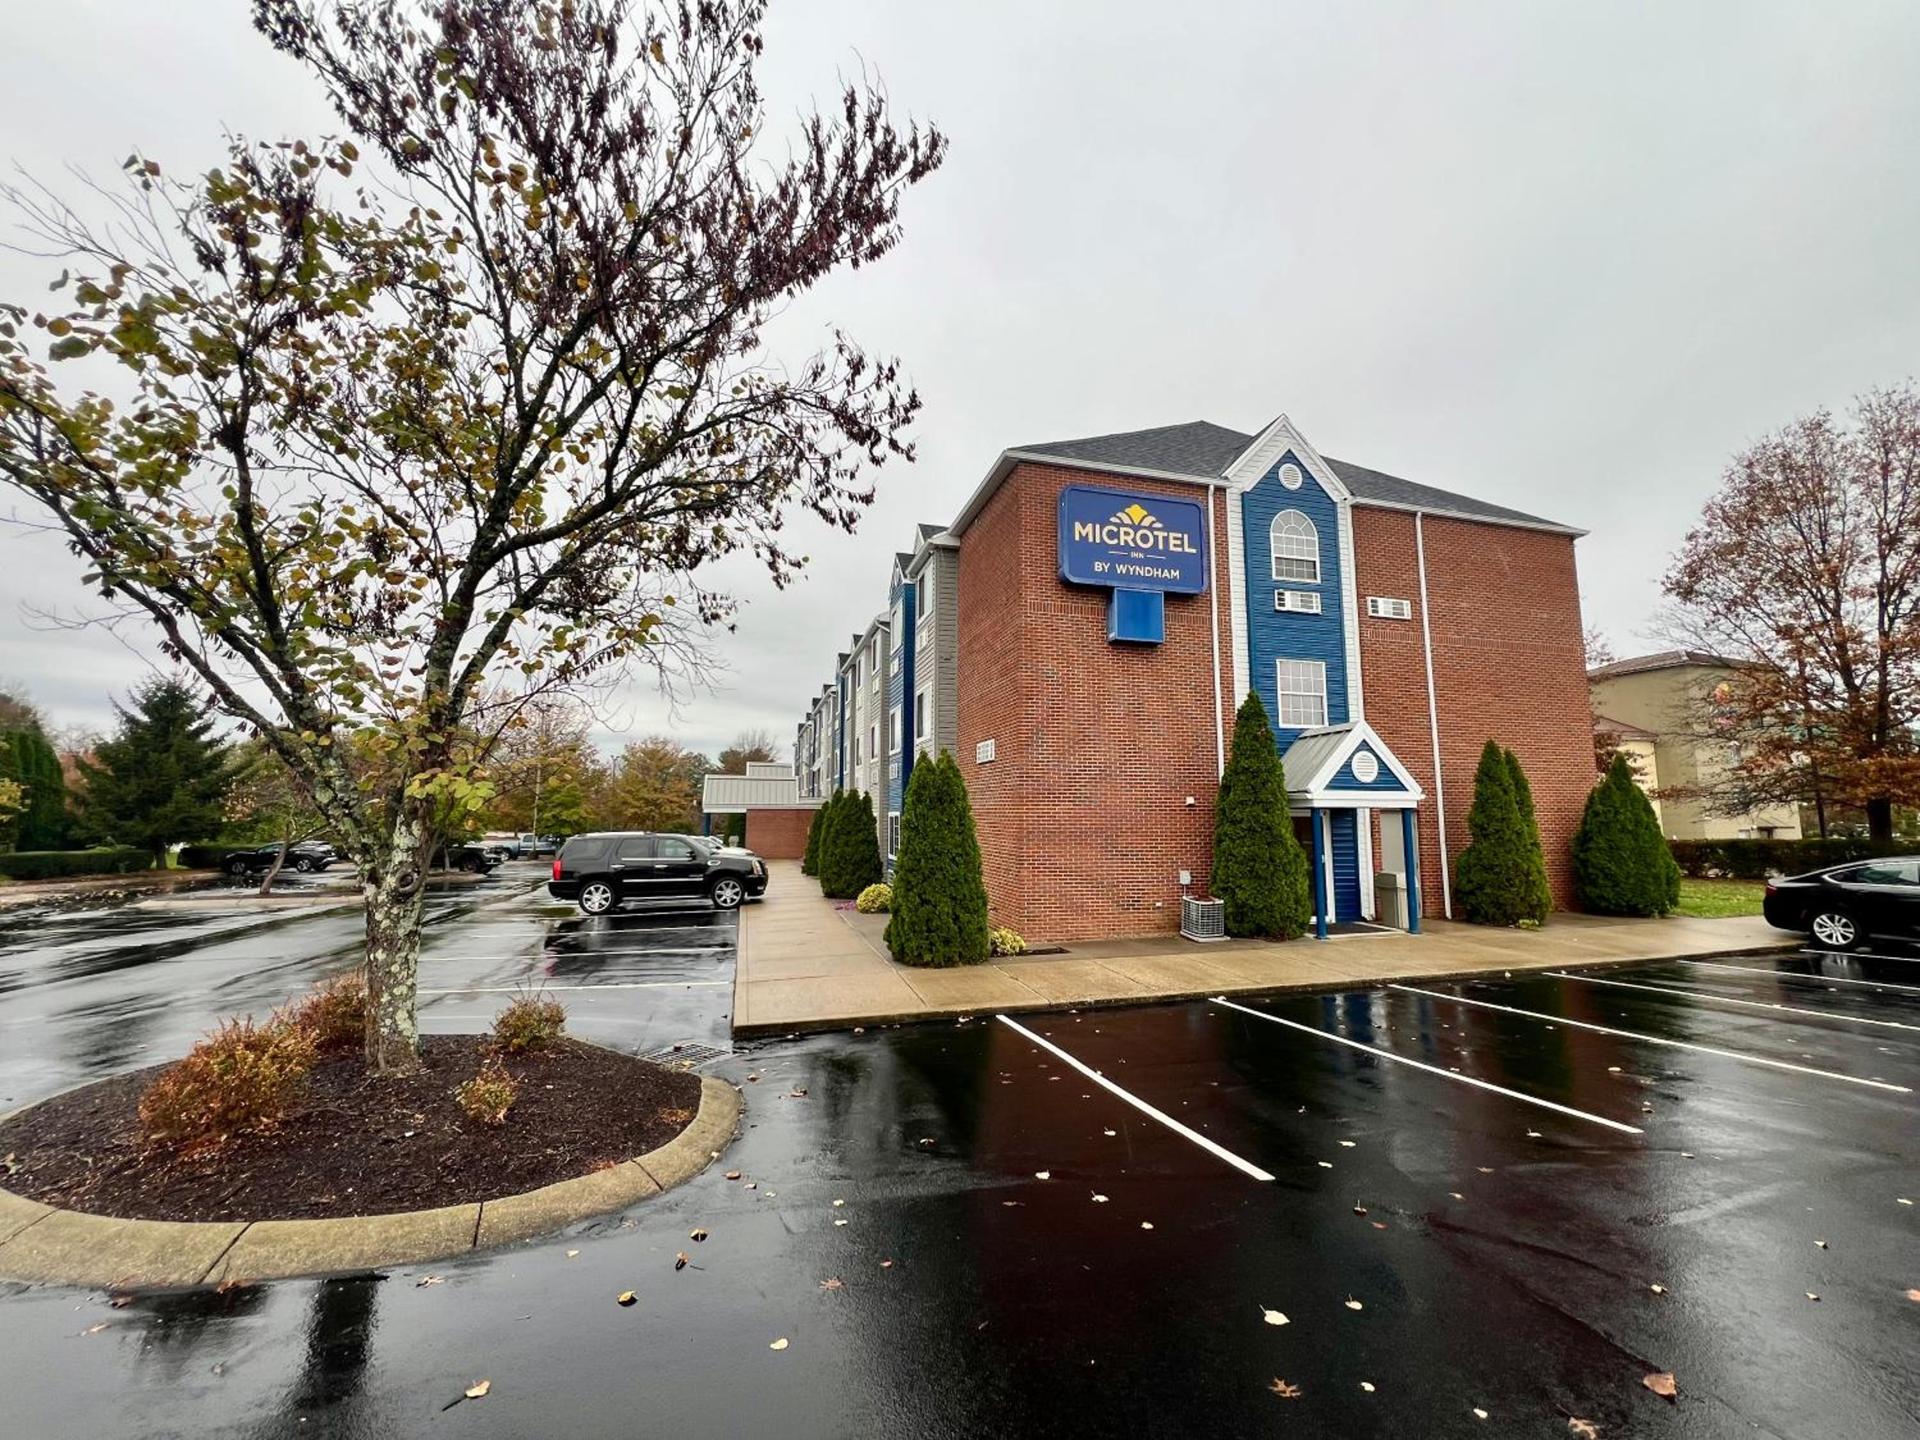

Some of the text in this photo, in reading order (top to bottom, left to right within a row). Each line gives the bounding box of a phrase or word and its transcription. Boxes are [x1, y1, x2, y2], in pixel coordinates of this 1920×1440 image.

[1074, 521, 1197, 554] MICROTEL
[1130, 551, 1145, 559] INN
[1094, 561, 1180, 580] BY WYNDHAM
